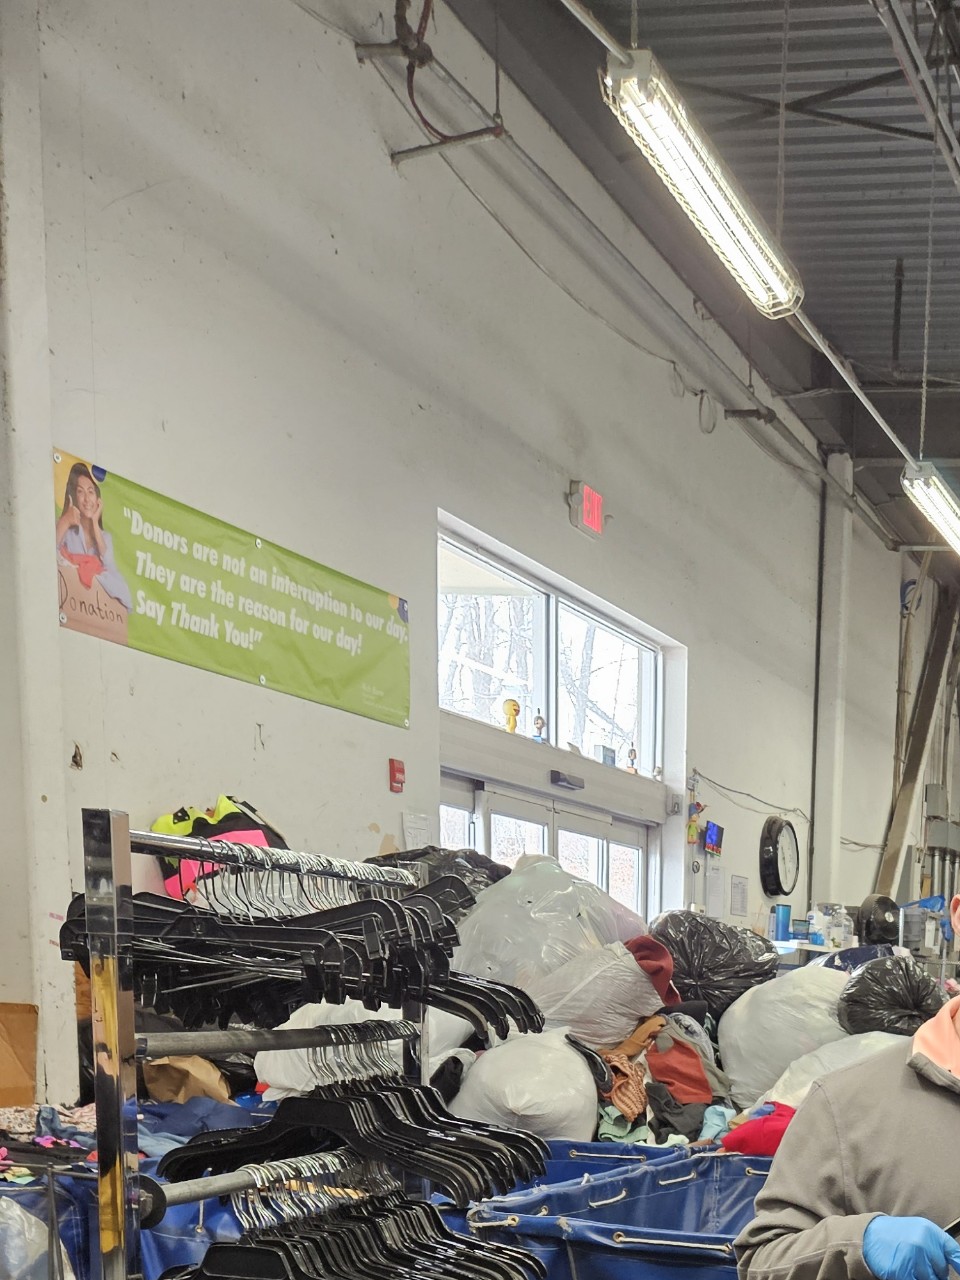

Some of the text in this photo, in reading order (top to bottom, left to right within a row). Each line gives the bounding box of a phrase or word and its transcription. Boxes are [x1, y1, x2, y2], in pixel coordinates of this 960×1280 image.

[58, 569, 123, 624] Donation
[123, 507, 408, 644] "Donors are not an interruption to our day.
[136, 550, 362, 656] They are the reason for our day!
[136, 590, 263, 650] Say Thank You!"
